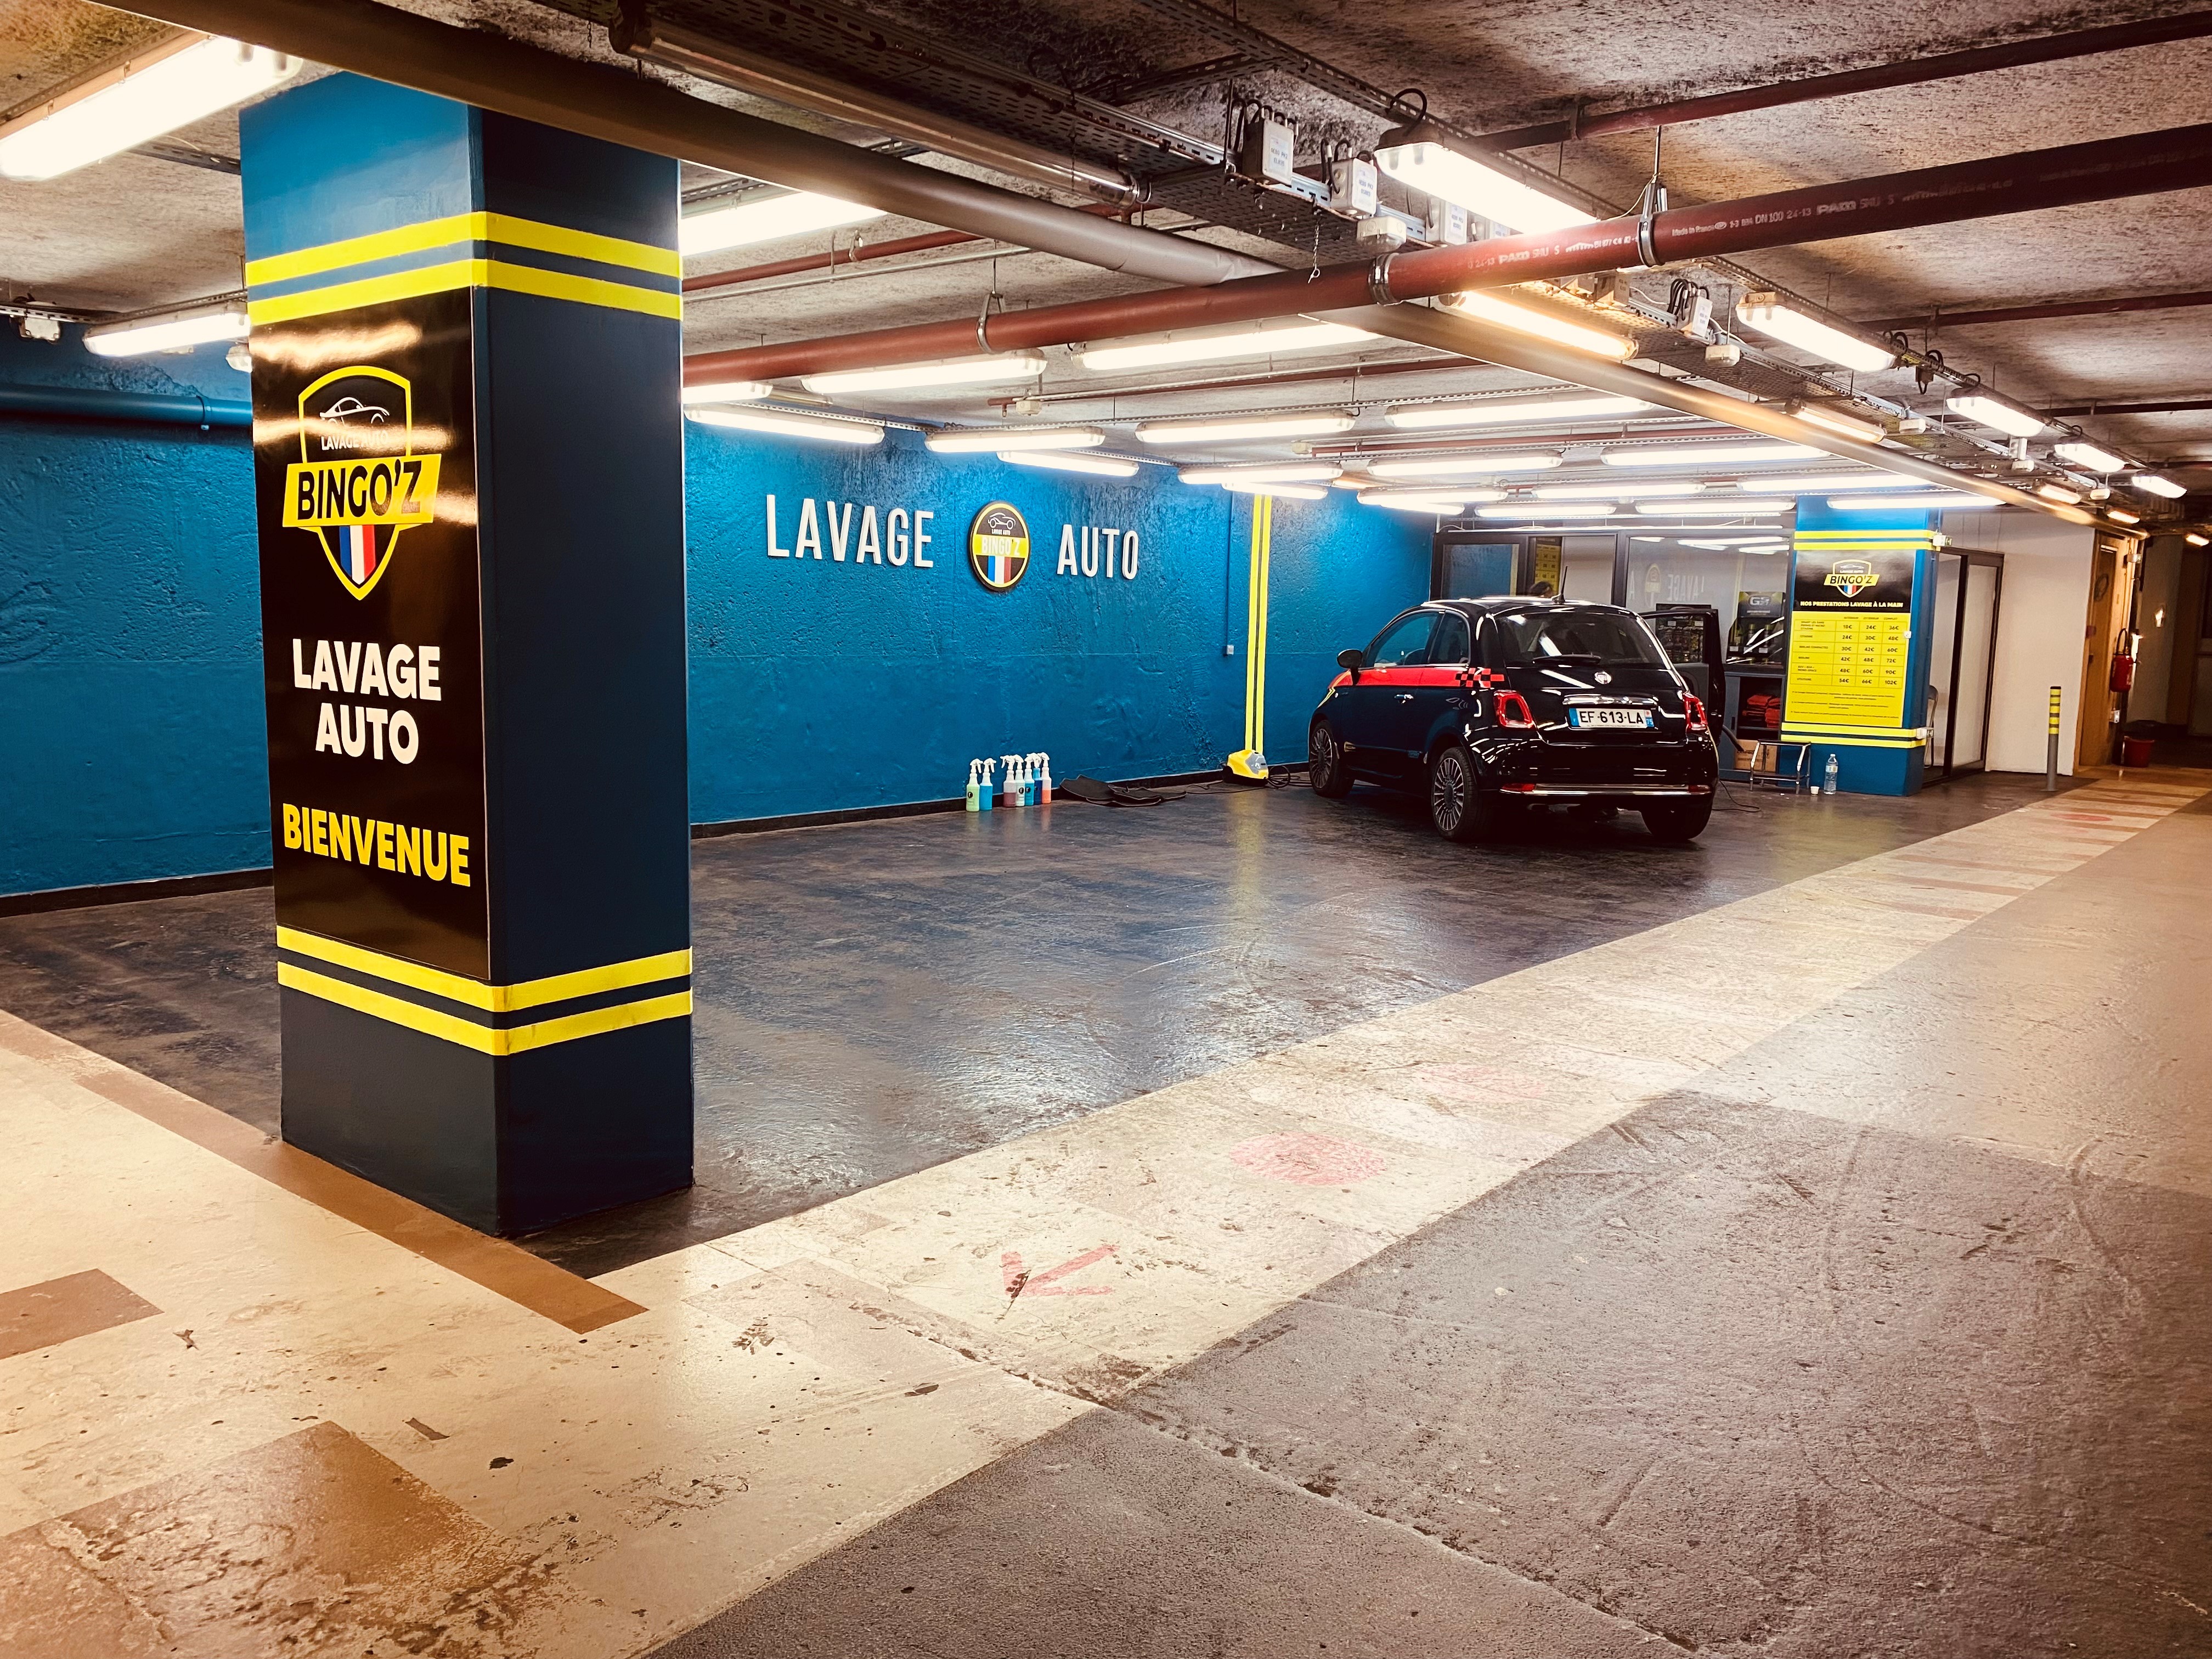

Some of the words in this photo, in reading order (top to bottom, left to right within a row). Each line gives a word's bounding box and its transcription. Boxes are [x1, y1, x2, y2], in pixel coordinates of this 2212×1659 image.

[298, 459, 422, 521] BINGO'Z
[766, 494, 935, 568] LAVAGE
[1057, 523, 1139, 580] AUTO
[1830, 575, 1873, 584] BINGO'Z
[292, 638, 441, 701] LAVAGE
[315, 702, 419, 764] AUTO
[283, 803, 471, 887] BIENVENUE
